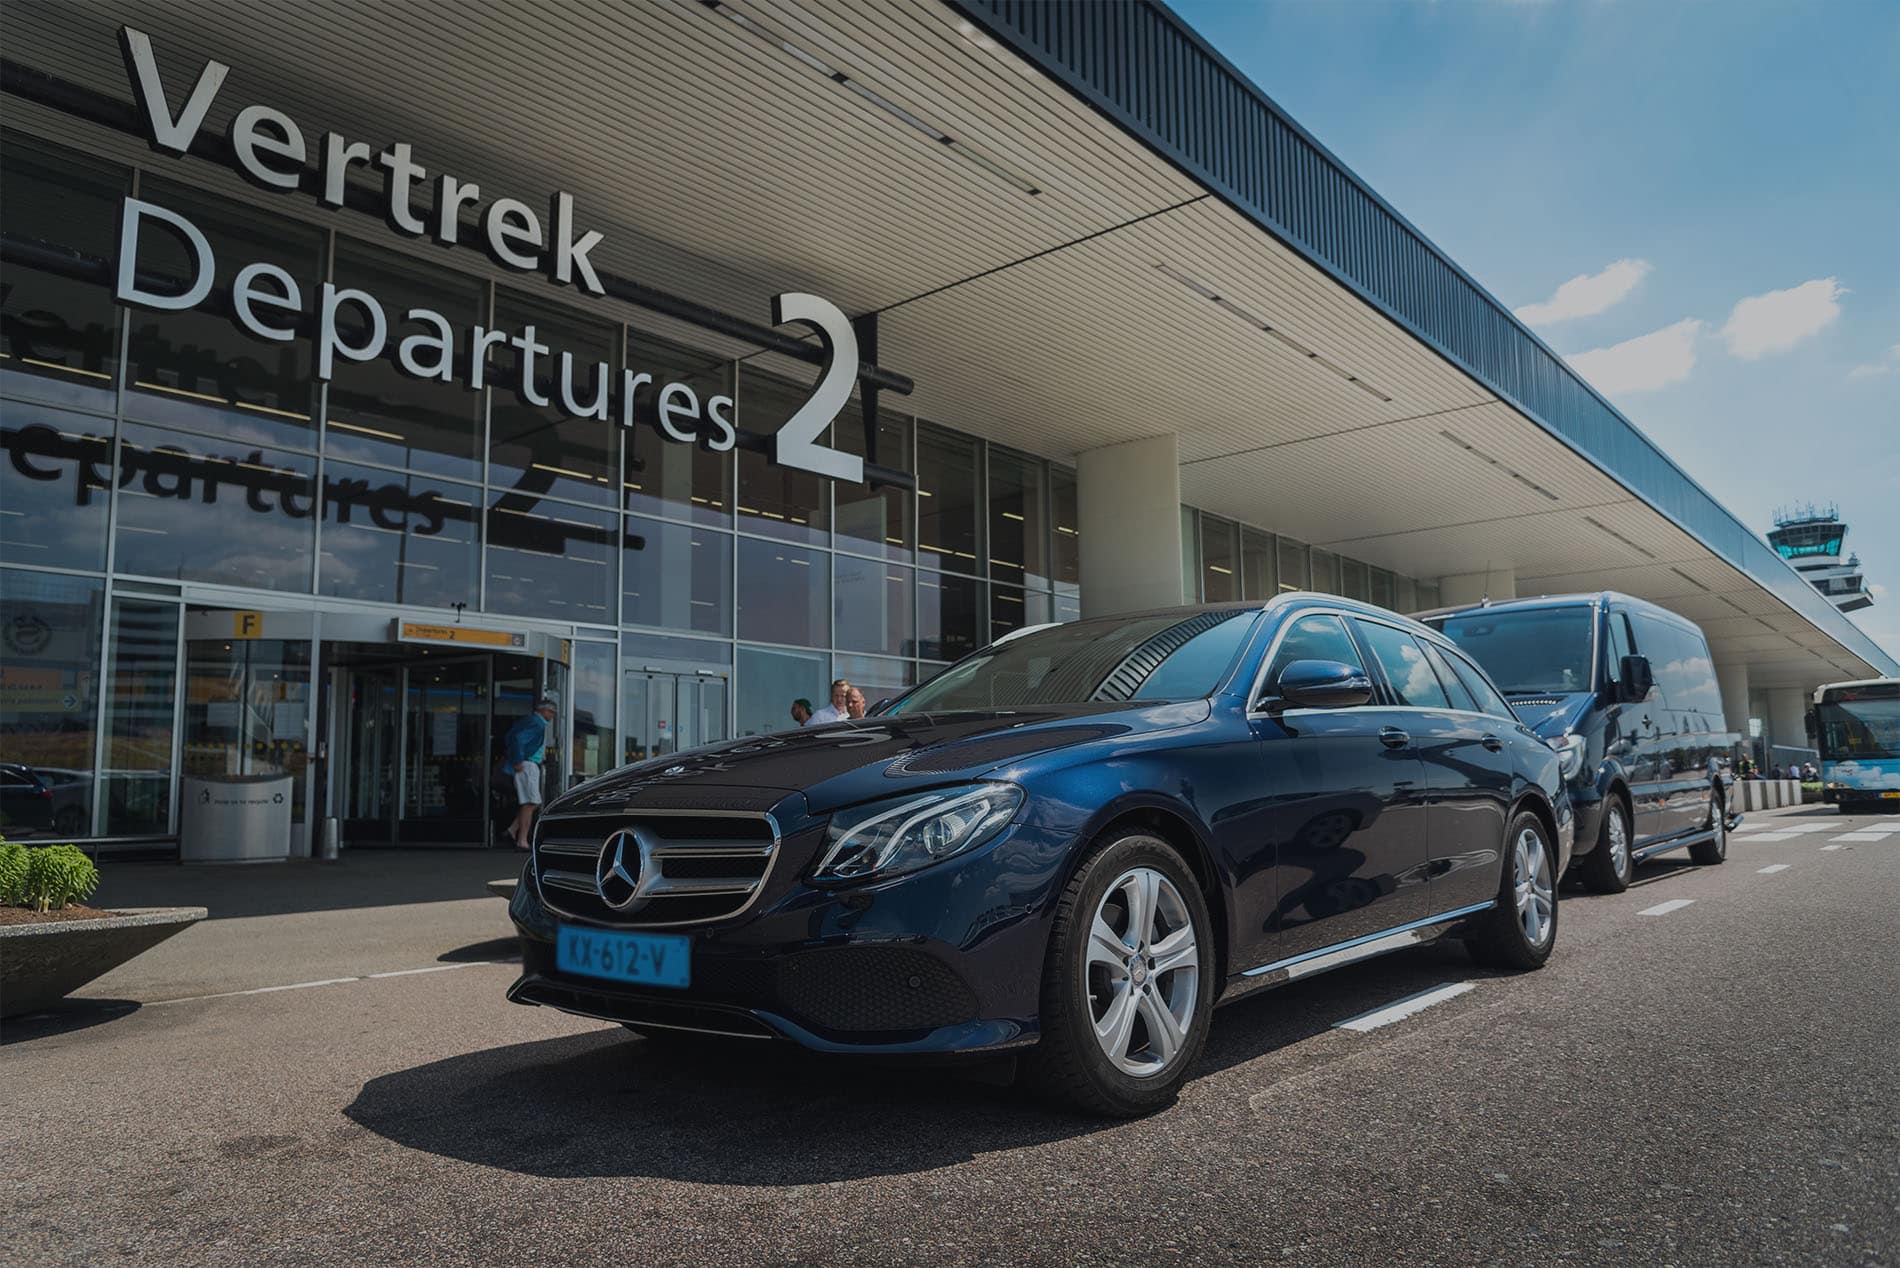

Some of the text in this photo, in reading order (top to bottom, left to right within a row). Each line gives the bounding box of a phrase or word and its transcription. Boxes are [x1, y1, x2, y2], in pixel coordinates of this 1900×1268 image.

[118, 24, 606, 296] Vertrek
[116, 196, 736, 452] Departures
[770, 292, 864, 484] 2
[242, 615, 255, 635] F
[449, 630, 456, 640] 2
[568, 935, 667, 977] KX-612-V
